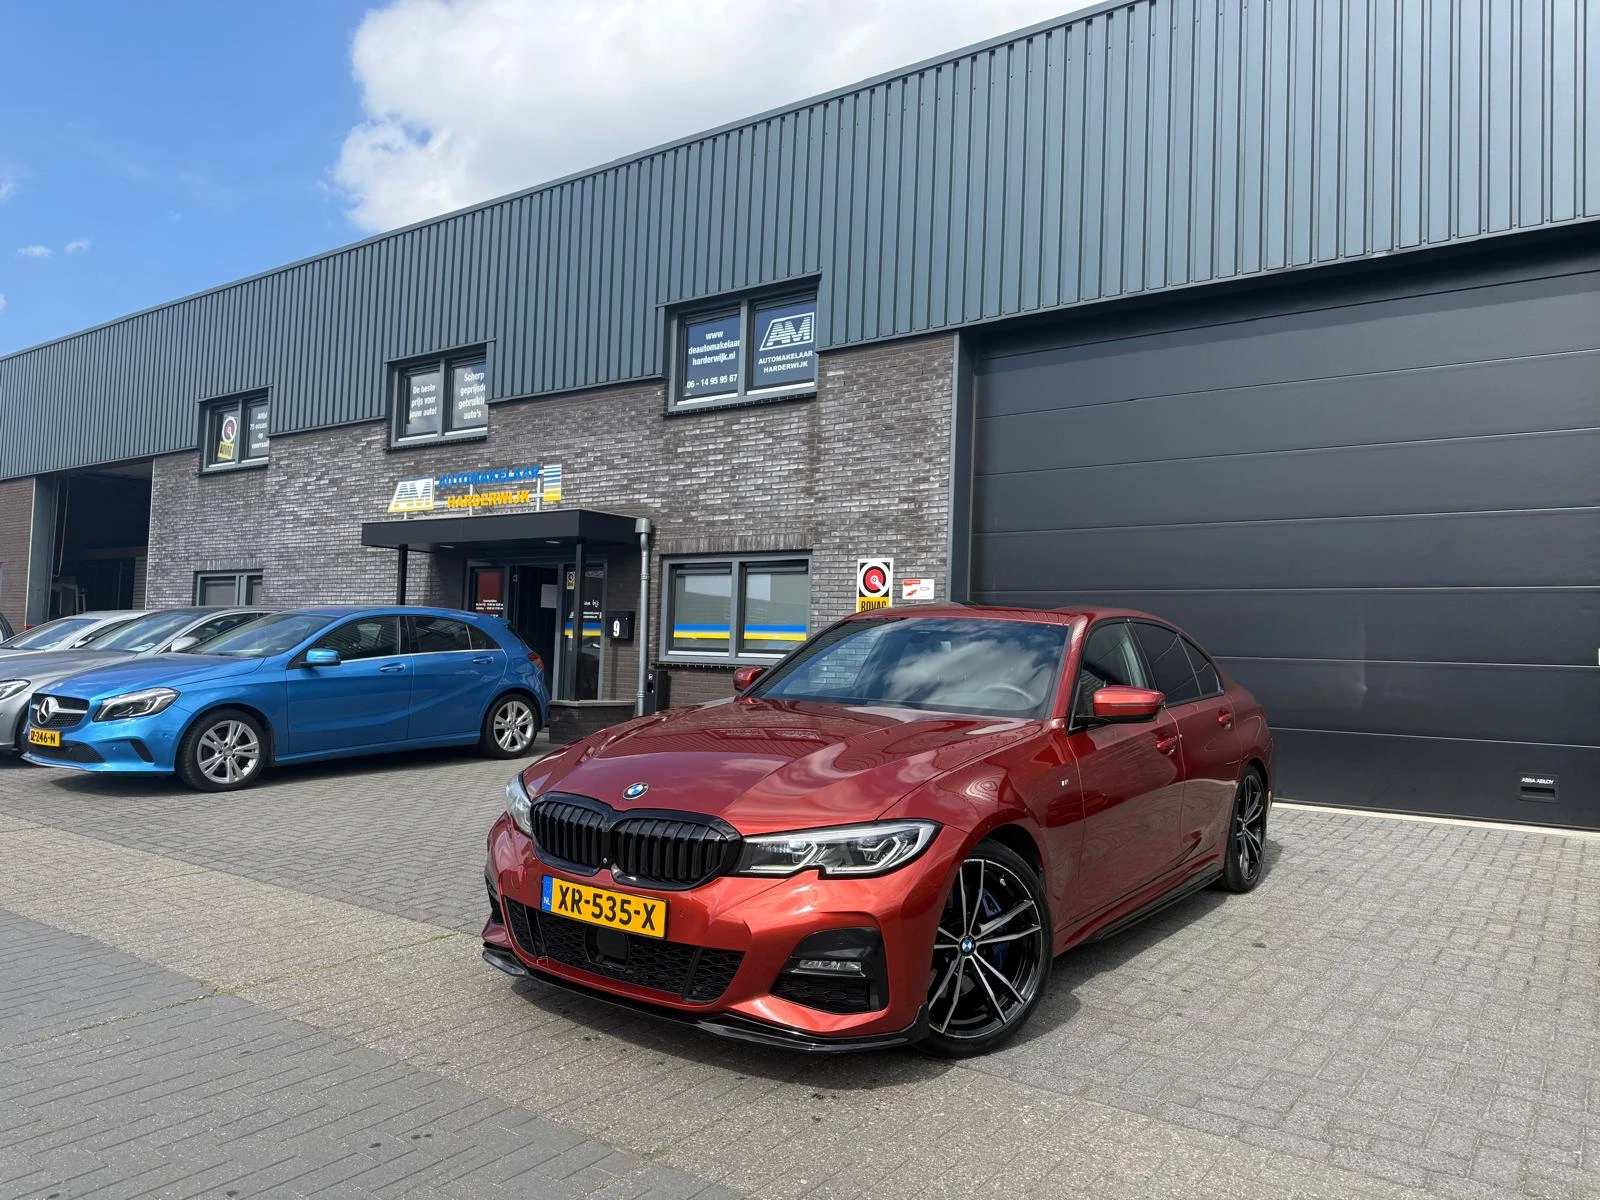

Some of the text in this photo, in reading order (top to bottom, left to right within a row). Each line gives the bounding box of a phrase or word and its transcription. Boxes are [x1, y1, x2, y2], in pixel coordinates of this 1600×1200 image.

[705, 330, 724, 340] www
[688, 340, 740, 355] deautomakelaar
[692, 351, 736, 366] harderwijk.nl
[758, 350, 813, 365] AUTOMAKELAAR
[763, 360, 809, 373] HARDERWIJK
[463, 372, 485, 382] Scherp
[686, 379, 695, 389] 06
[701, 378, 709, 386] 14
[709, 376, 719, 385] 95
[719, 375, 728, 384] 95
[412, 384, 436, 394] De beste
[424, 395, 437, 404] voor
[438, 465, 541, 488] AUTOMAKELAAR
[447, 490, 531, 509] HARDERWIJK
[612, 620, 621, 638] 9
[558, 885, 656, 931] XR-535-X
